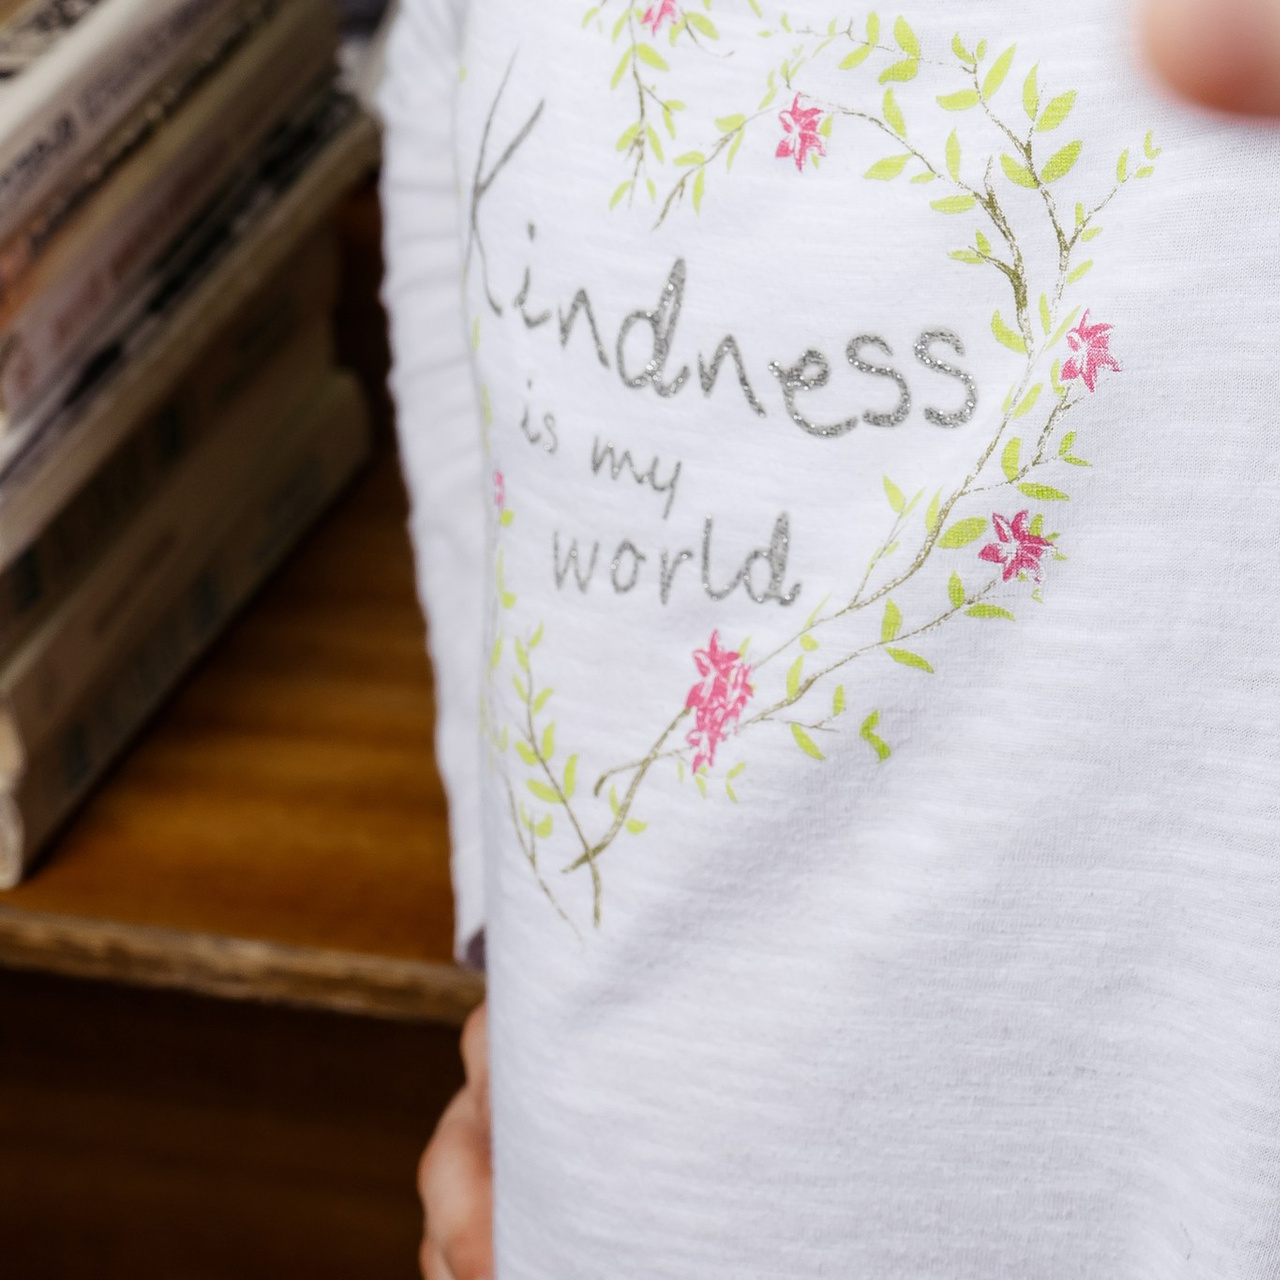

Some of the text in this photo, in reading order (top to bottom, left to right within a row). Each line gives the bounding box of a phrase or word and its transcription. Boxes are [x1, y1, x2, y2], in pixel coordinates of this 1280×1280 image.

[464, 44, 980, 439] Kindness
[519, 379, 682, 519] is my
[553, 510, 801, 608] world
